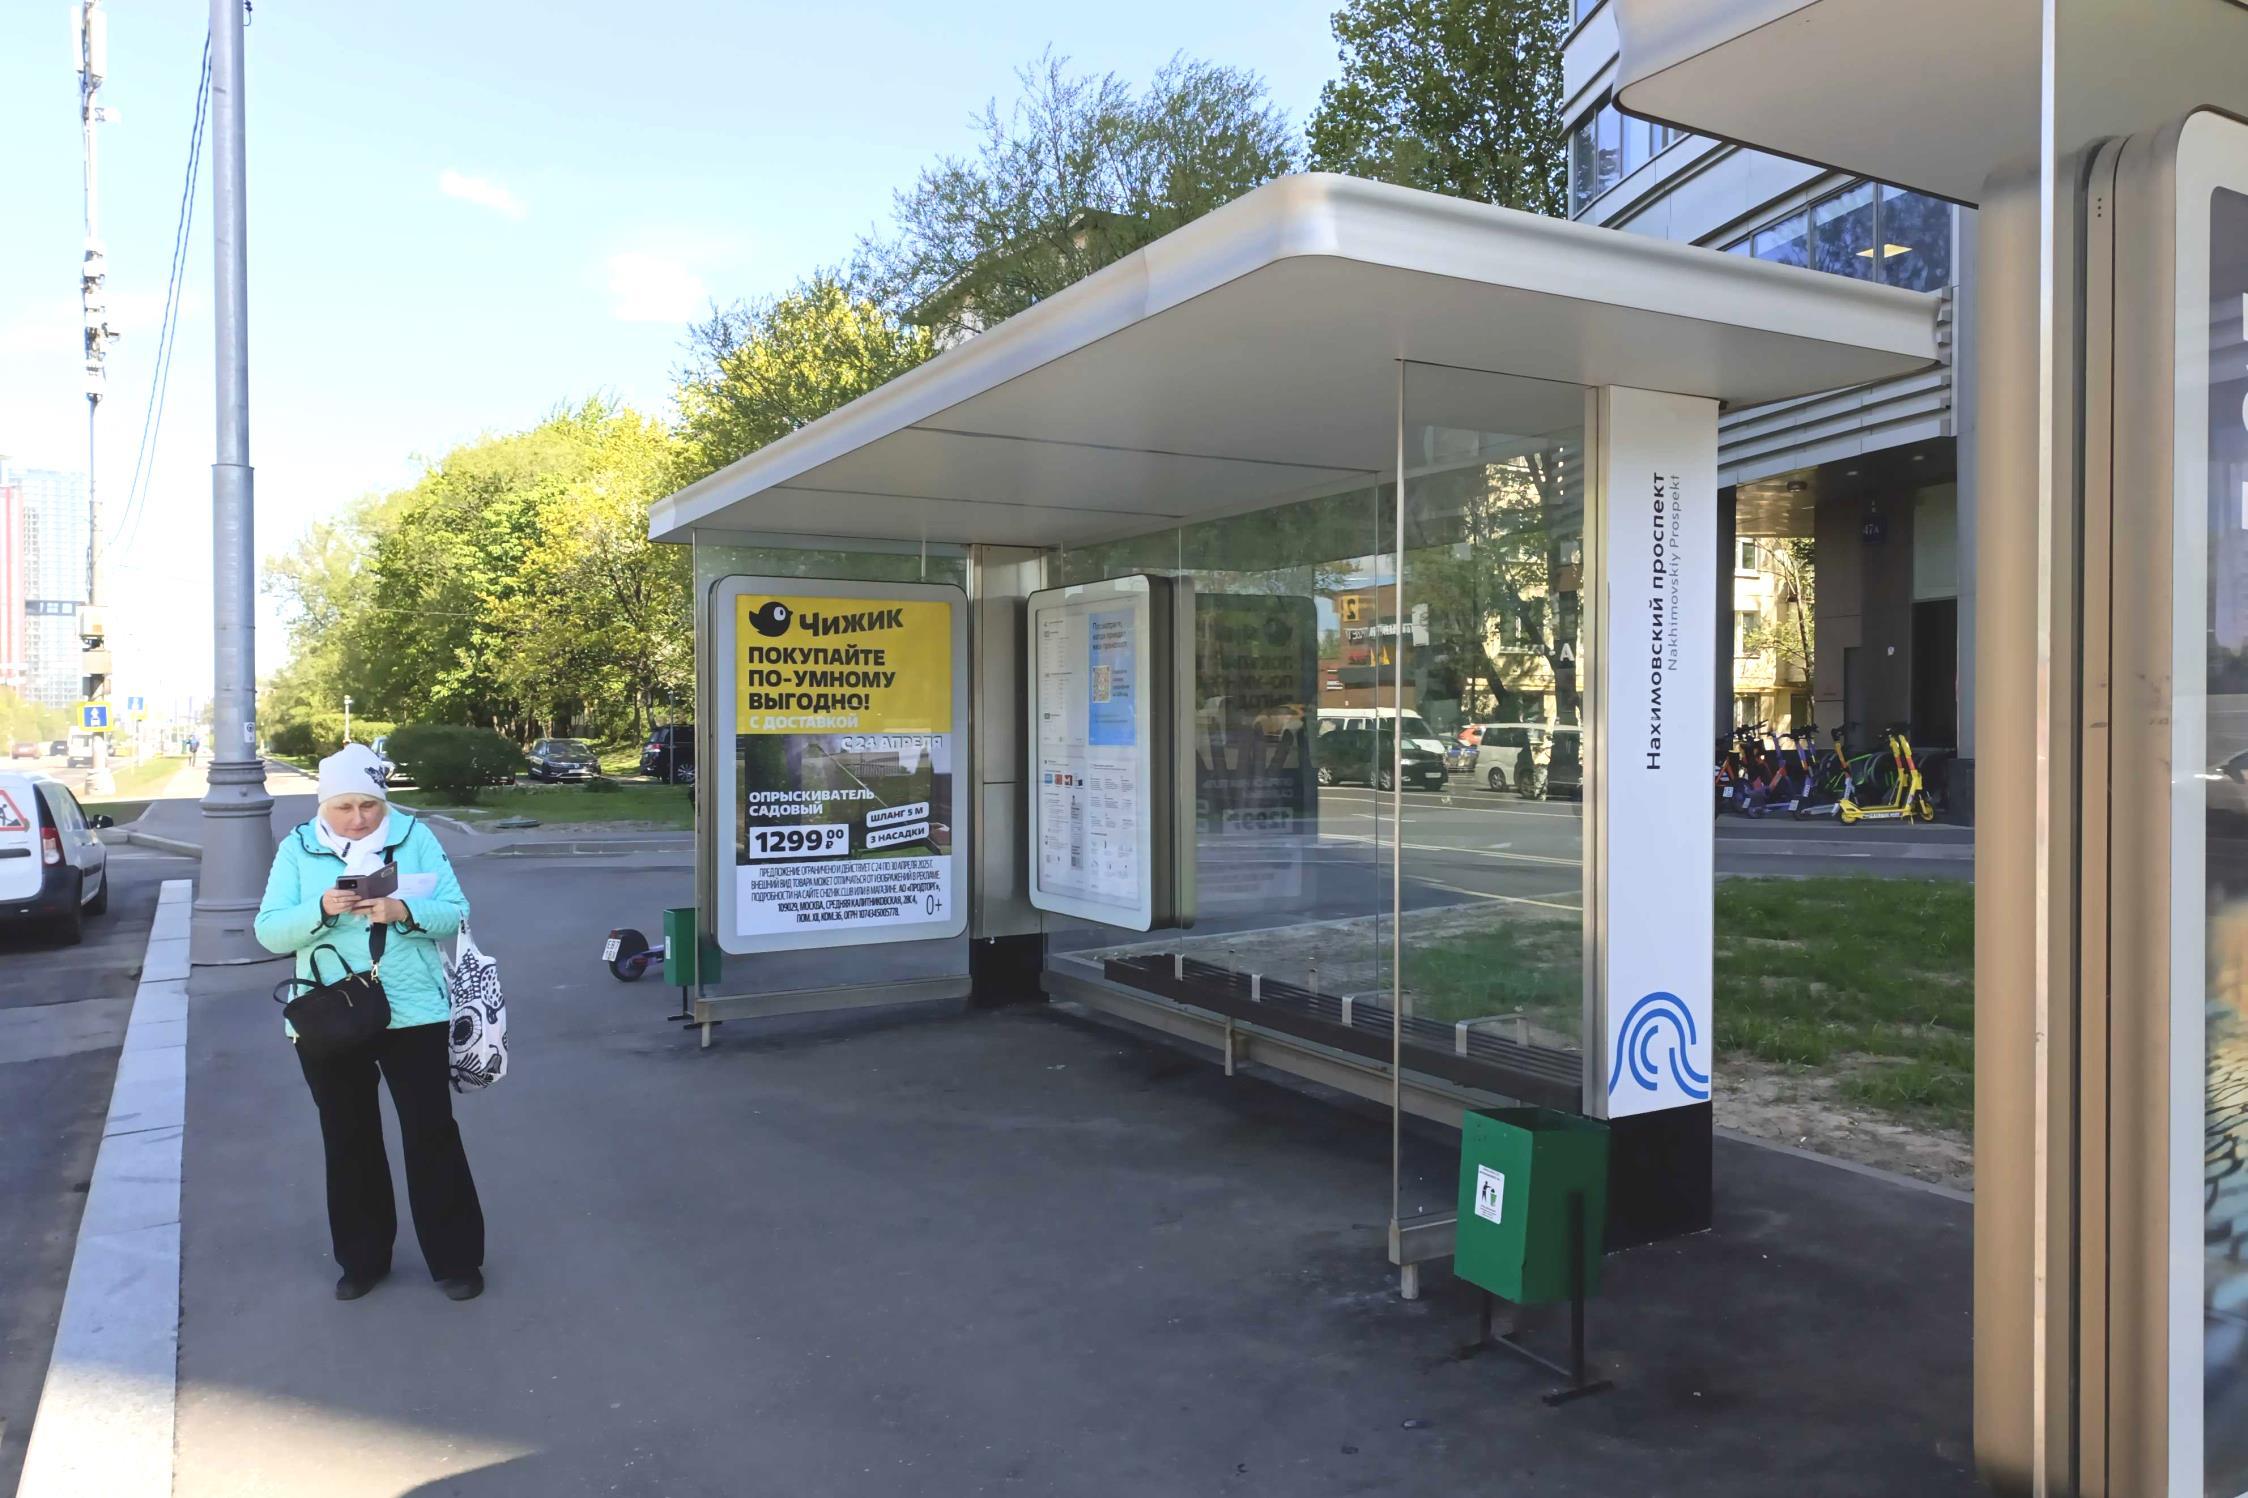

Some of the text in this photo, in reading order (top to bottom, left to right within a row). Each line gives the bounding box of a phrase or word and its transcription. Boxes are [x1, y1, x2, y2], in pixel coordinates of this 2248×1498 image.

[1668, 475, 1682, 671] Nakhimovskiy Prospekt
[1646, 472, 1667, 770] Нахимовский проспект
[748, 643, 886, 667] ПОКУПАЙТЕ
[748, 670, 896, 688] ПО-УМНОМУ
[748, 692, 870, 714] ВЫГОДНО!
[750, 713, 859, 731] С ДОСТАВКОЙ
[840, 735, 943, 751] С 24 АПРЕЛЯ
[749, 789, 875, 803] ОПРЫСКИВАТЕЛЬ
[749, 800, 823, 817] САДОВЫЙ
[870, 807, 923, 823] ШЛАНГ 5 М
[755, 829, 844, 853] 1299 00
[870, 827, 925, 844] 3 НАСАДКИ
[926, 894, 942, 915] 0+
